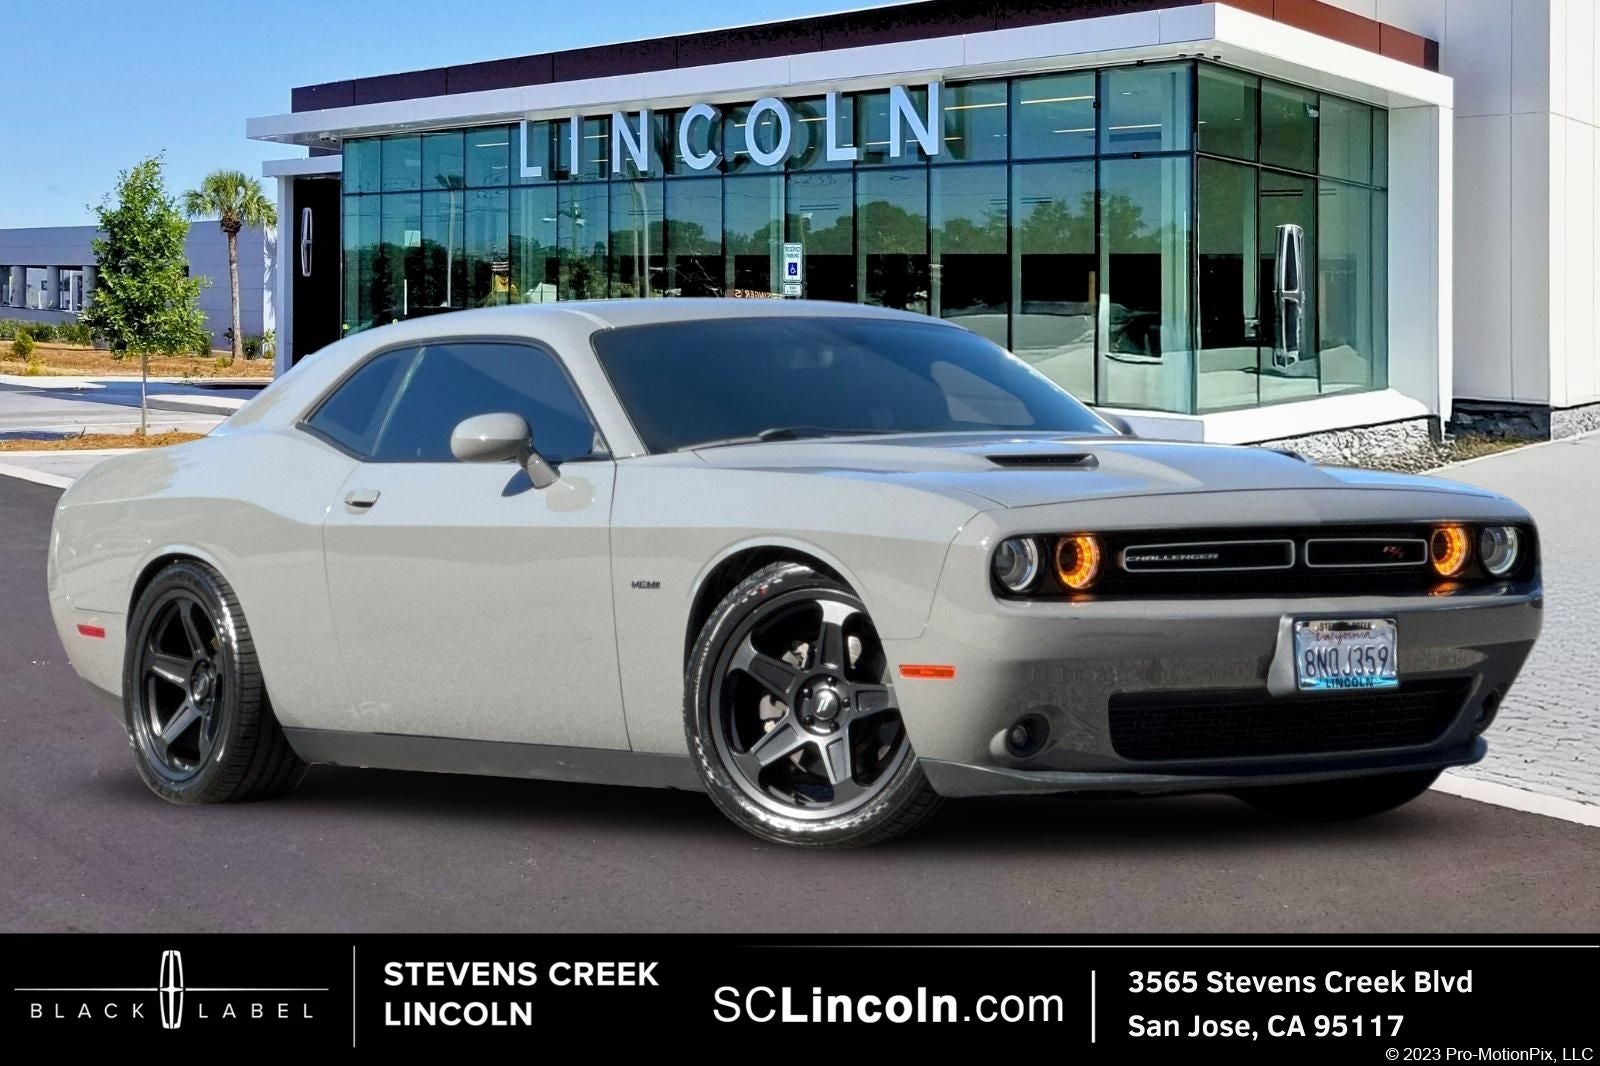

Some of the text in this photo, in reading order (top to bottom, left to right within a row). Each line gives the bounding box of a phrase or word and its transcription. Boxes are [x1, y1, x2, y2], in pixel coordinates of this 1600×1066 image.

[520, 80, 944, 178] LINCOLN
[1125, 553, 1219, 562] CHALLENGER
[1316, 631, 1371, 645] California
[1325, 677, 1374, 688] LINCOLN
